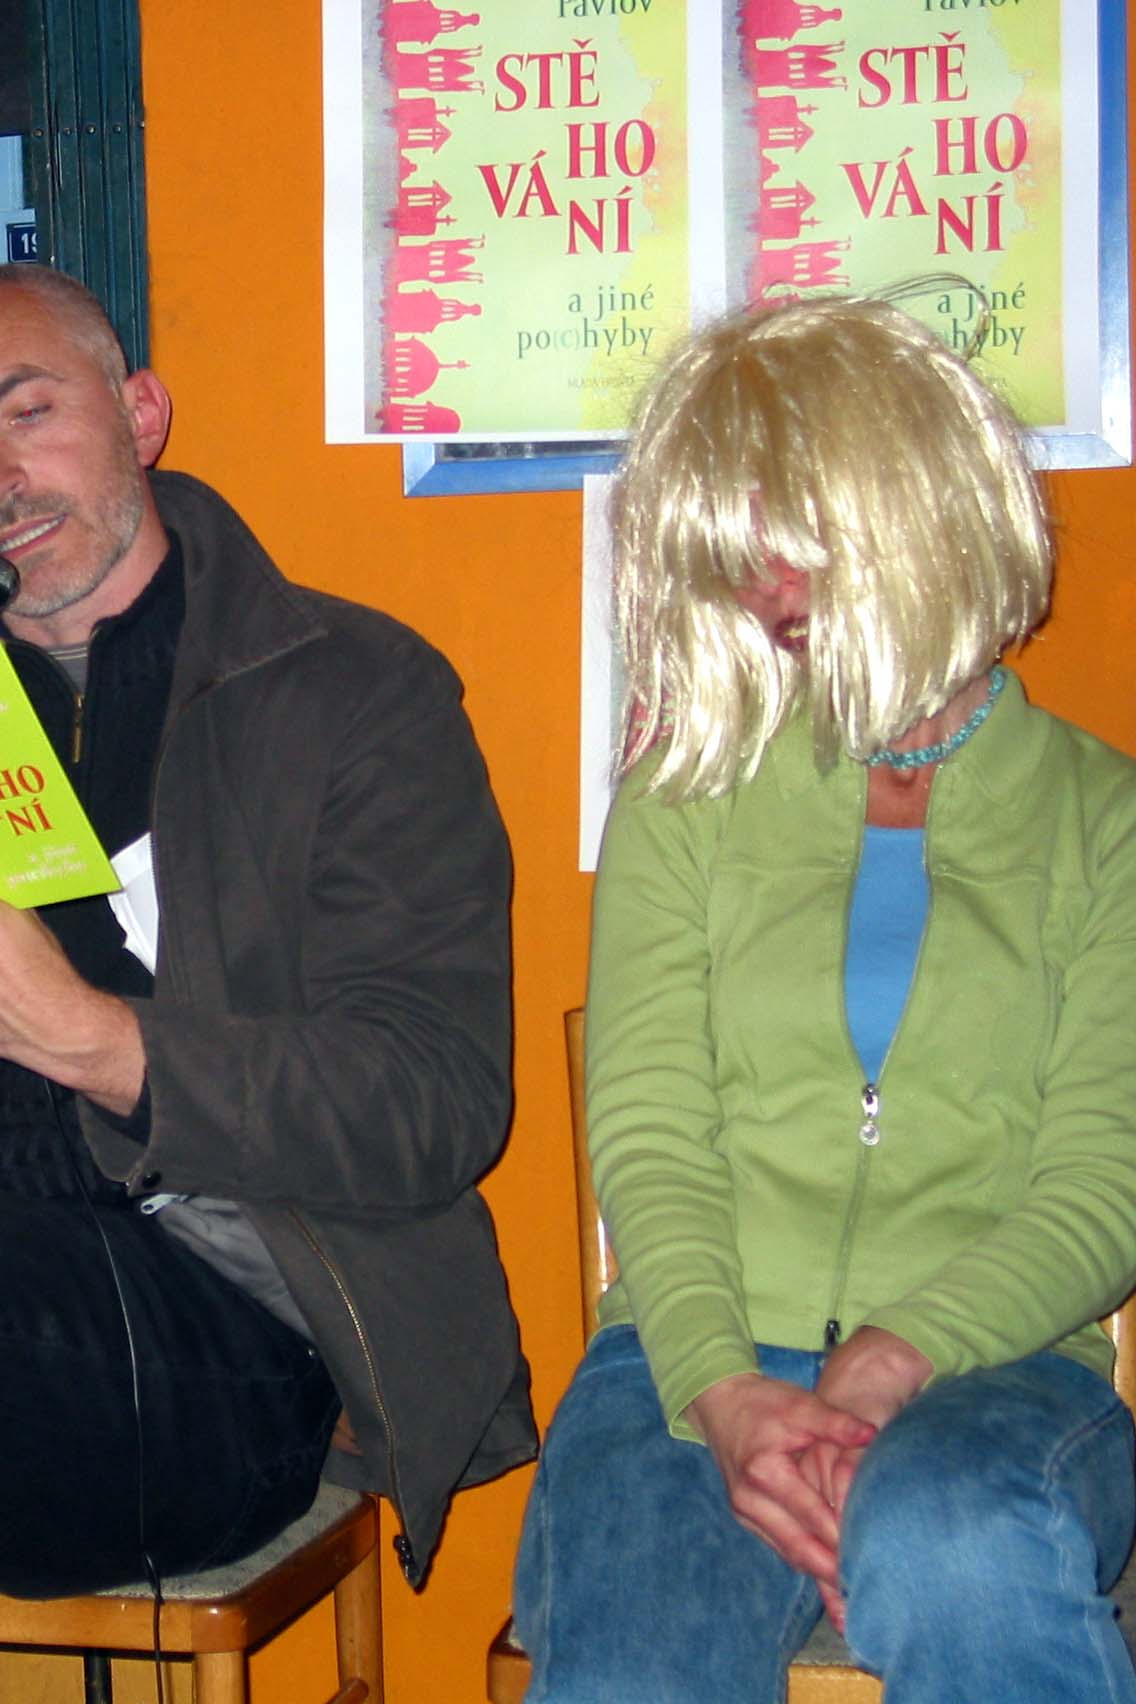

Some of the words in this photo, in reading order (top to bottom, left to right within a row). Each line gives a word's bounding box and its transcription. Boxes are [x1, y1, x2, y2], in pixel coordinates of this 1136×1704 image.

[495, 38, 600, 112] STĚ
[858, 31, 968, 108] STĚ
[564, 119, 655, 179] HO
[931, 113, 1027, 176] HO
[475, 150, 561, 218] VÁ
[838, 147, 930, 219] VÁ
[566, 185, 632, 255] NÍ
[934, 181, 1005, 255] NÍ
[568, 293, 581, 313] a
[594, 283, 654, 321] jiné
[937, 293, 951, 313] a
[964, 281, 1025, 322] jné
[517, 316, 654, 359] po(c)hyby
[5, 797, 54, 836] NÍ
